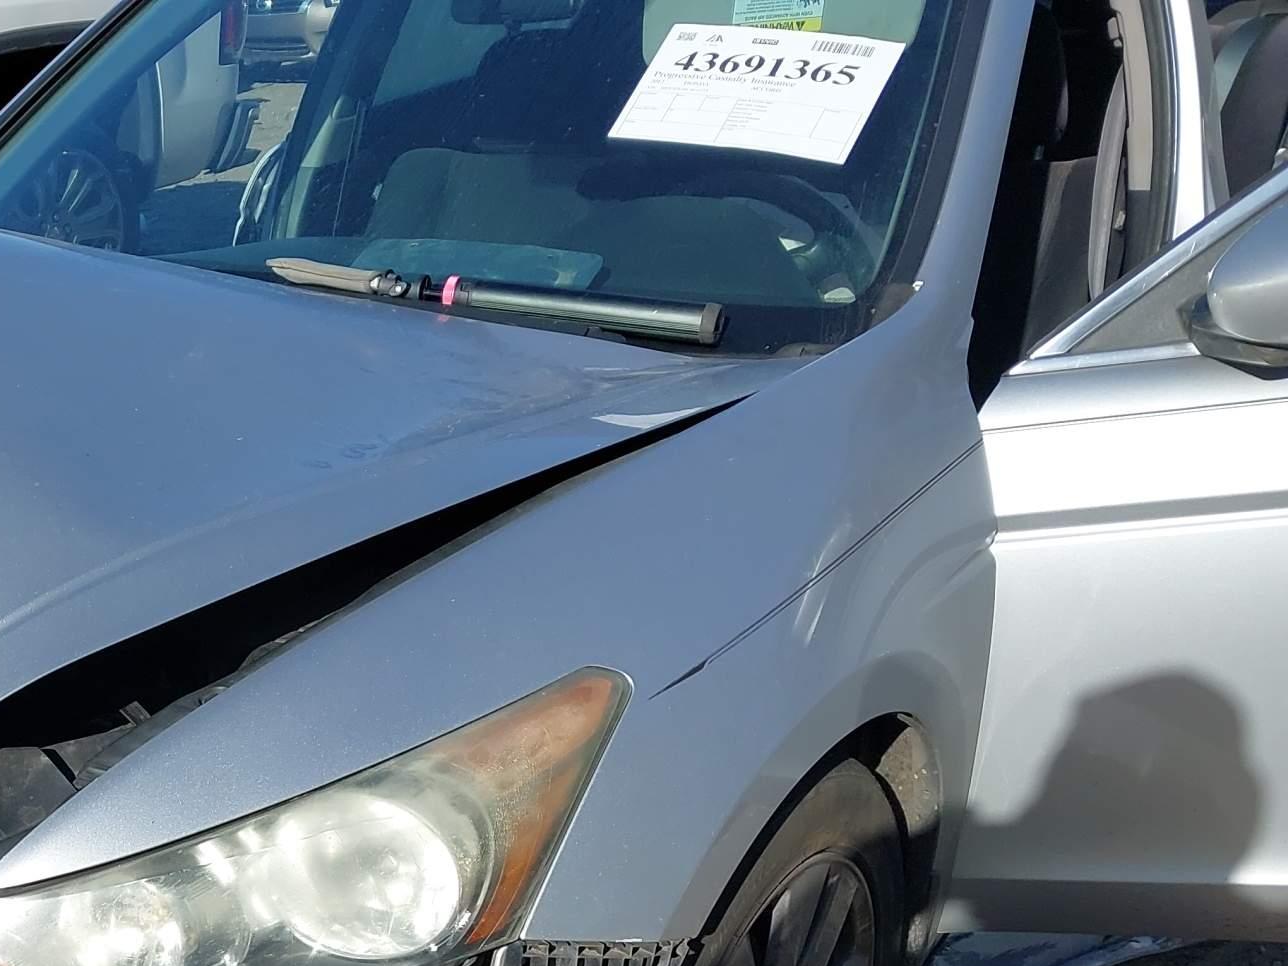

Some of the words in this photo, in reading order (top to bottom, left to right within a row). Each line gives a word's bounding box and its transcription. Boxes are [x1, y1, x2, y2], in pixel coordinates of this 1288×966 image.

[654, 71, 707, 80] Progressive
[708, 74, 747, 84] Casualty
[674, 50, 861, 86] 43691365
